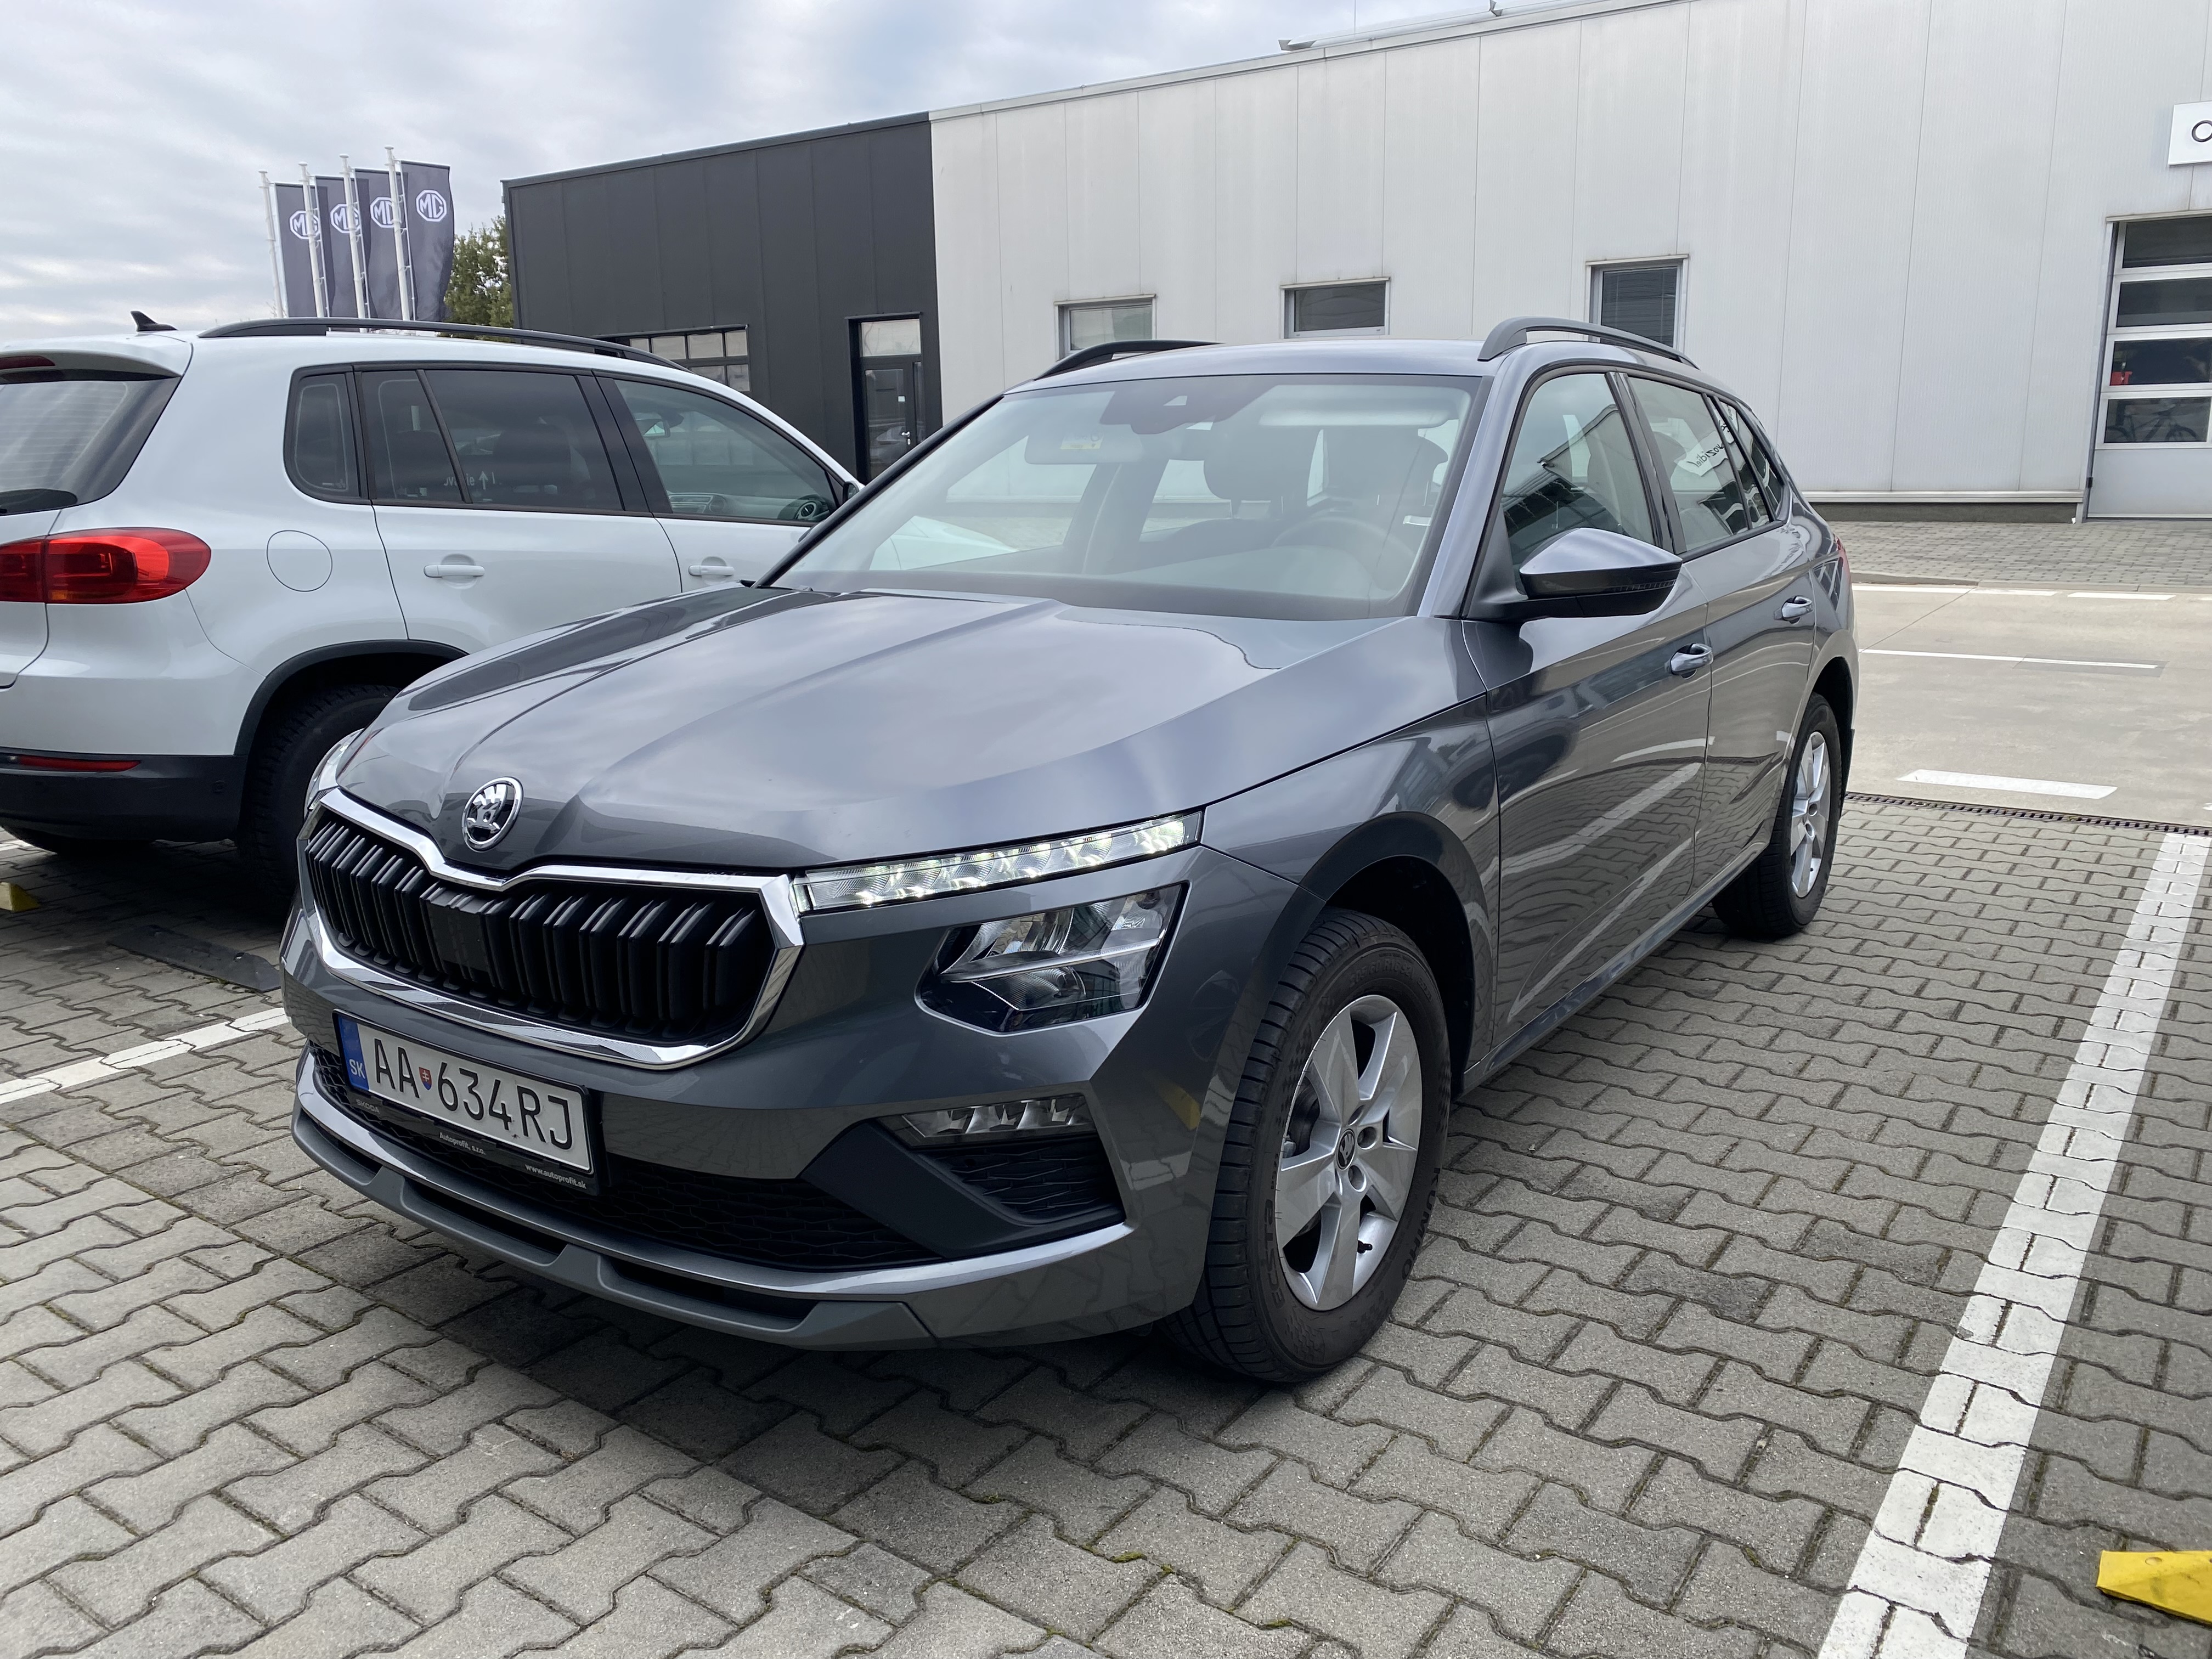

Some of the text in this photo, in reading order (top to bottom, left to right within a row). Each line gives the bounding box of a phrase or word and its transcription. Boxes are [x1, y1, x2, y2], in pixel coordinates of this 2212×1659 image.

[419, 193, 443, 218] MG
[349, 1059, 366, 1080] SK
[439, 1132, 486, 1155] Autoprofit, s.r.o.
[524, 1164, 586, 1189] www.autoprofit.sk
[1401, 1167, 1441, 1281] KUMHO
